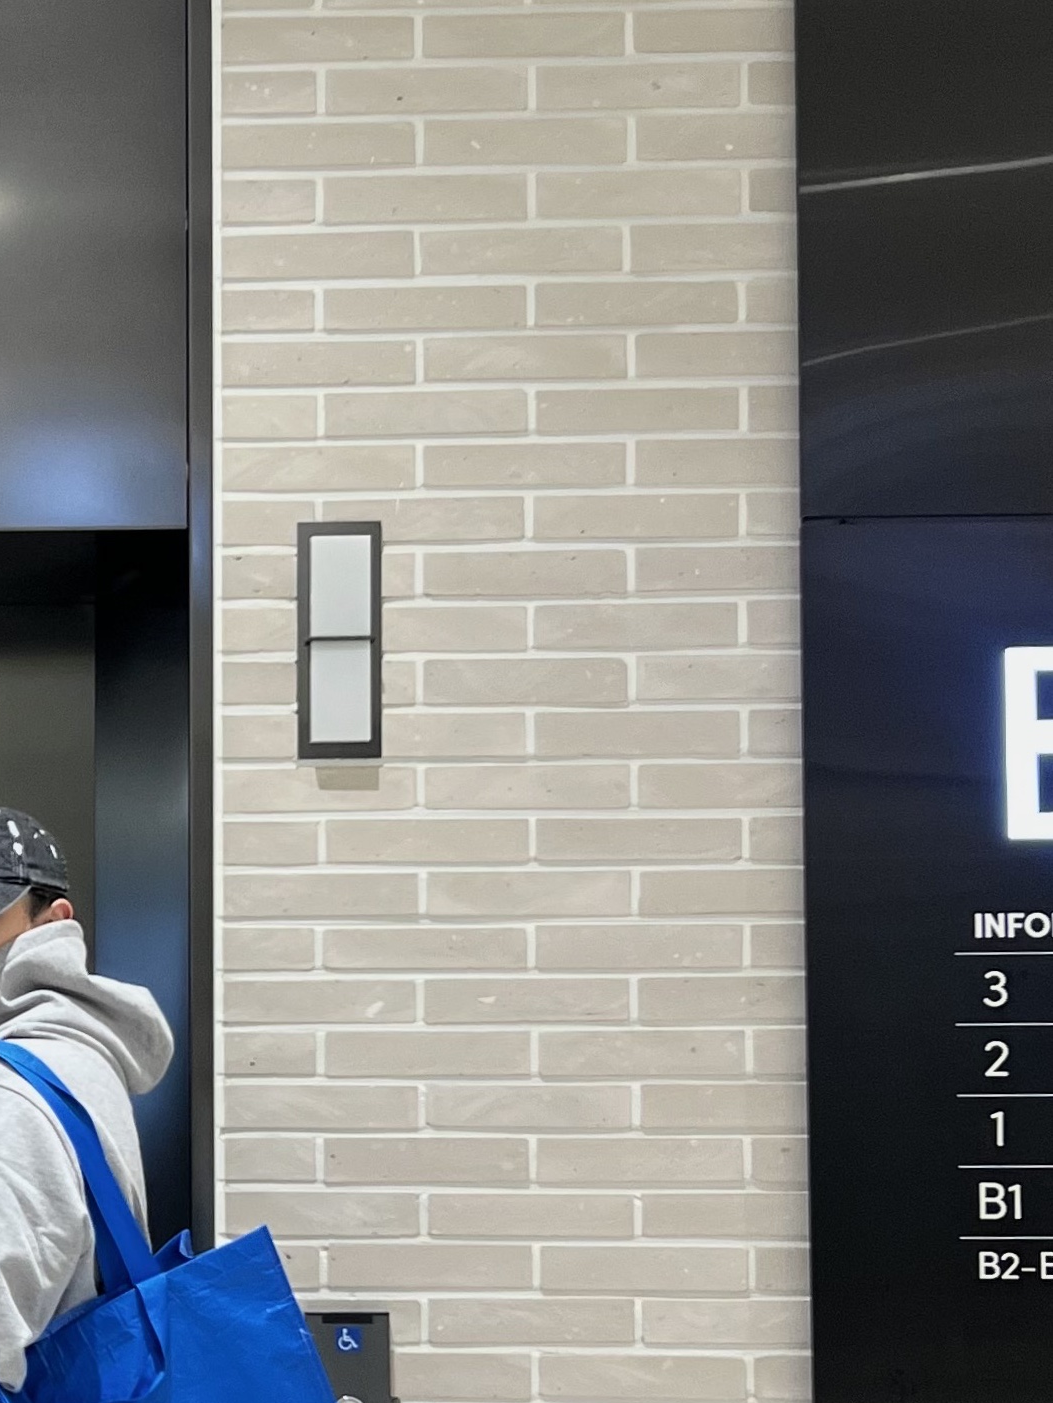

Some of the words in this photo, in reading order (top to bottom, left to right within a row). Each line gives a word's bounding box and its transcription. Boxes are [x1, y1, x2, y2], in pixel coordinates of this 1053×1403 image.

[974, 912, 1053, 938] INFO
[982, 970, 1008, 1007] 3
[984, 1040, 1010, 1077] 2
[989, 1110, 1005, 1147] 1
[978, 1182, 1022, 1220] B1
